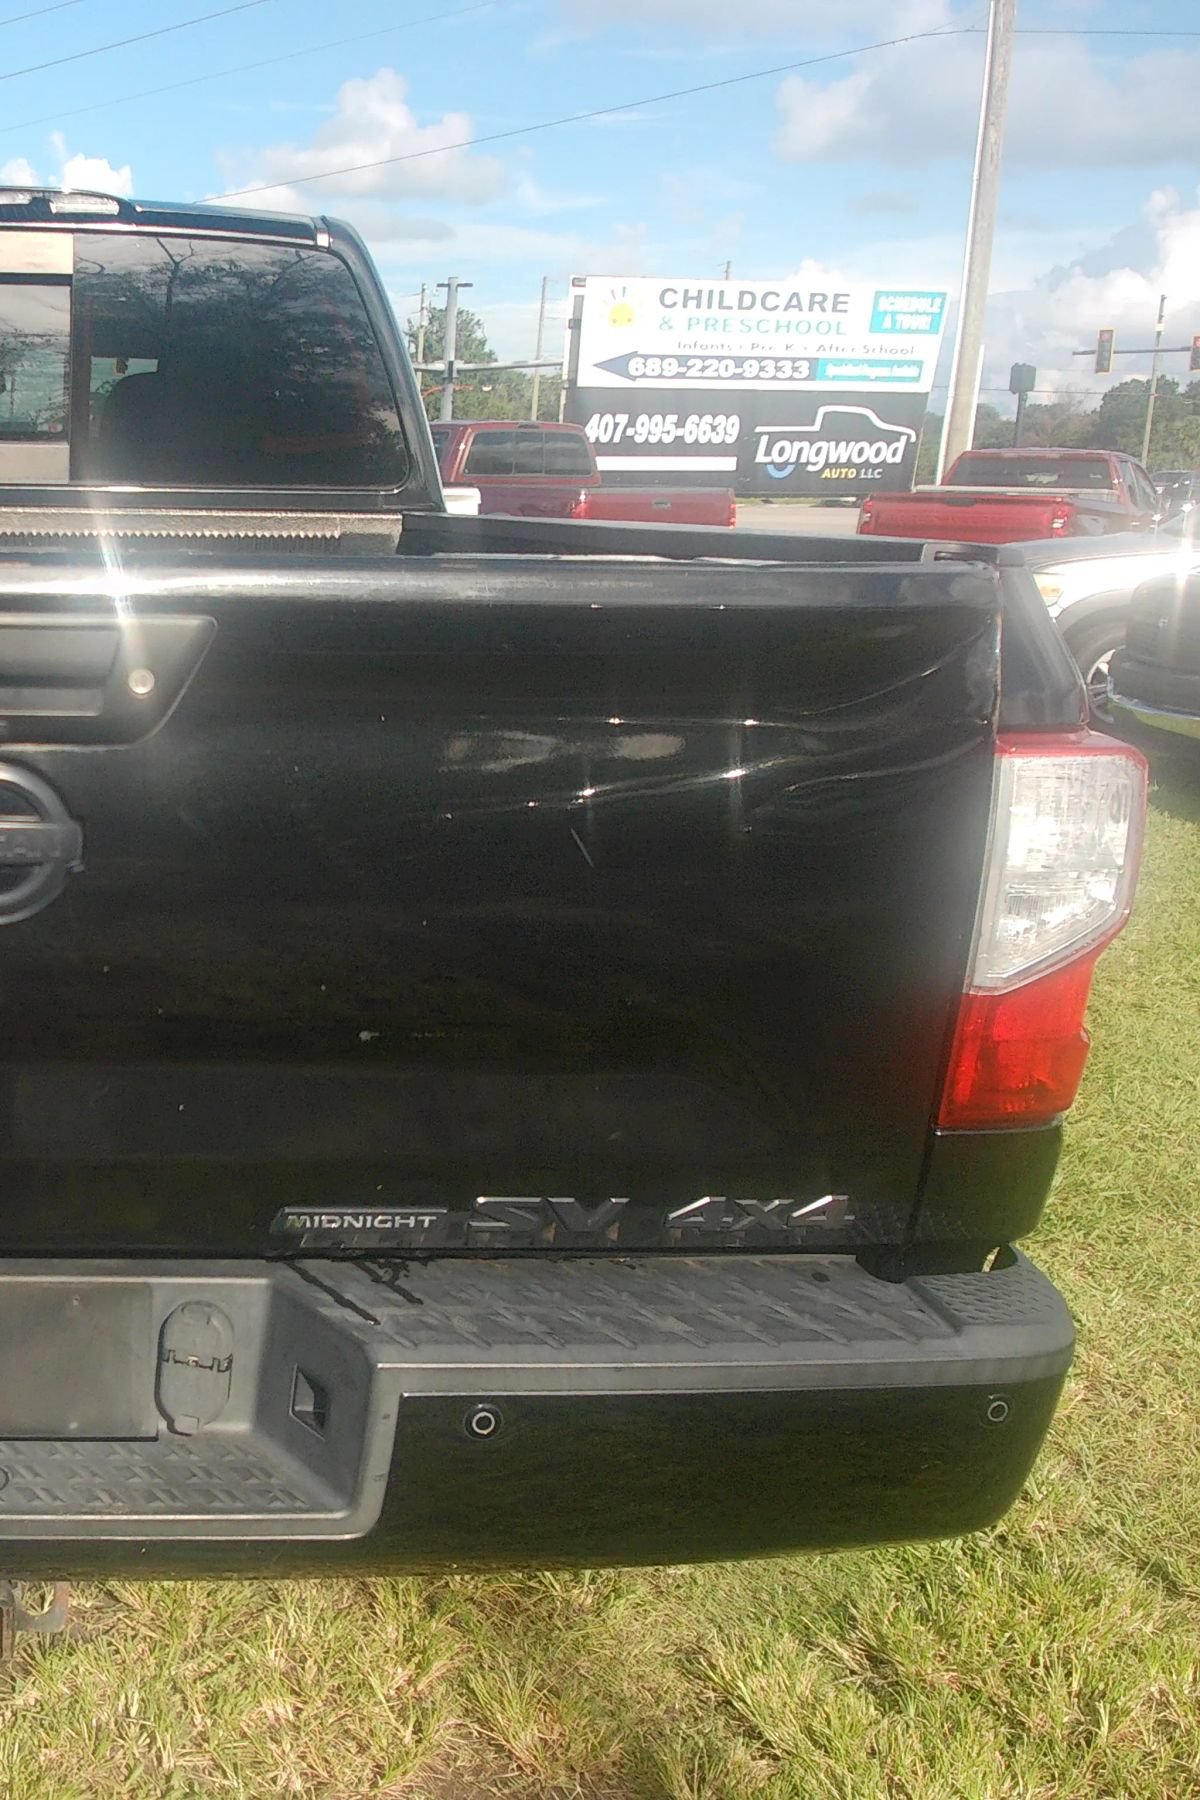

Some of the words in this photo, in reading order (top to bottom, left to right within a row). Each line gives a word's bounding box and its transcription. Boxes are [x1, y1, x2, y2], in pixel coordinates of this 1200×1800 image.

[658, 287, 851, 314] CHILDCARE
[658, 316, 669, 331] &
[687, 316, 848, 336] PRESCHOOL
[862, 345, 915, 355] School
[628, 357, 811, 379] 689-220-9333
[584, 413, 740, 444] 407-995-6639
[754, 435, 908, 472] Longwood
[821, 468, 856, 479] AUTO
[859, 469, 883, 479] LLC
[285, 1213, 438, 1230] MIDNIGHT
[467, 1196, 631, 1230] SV
